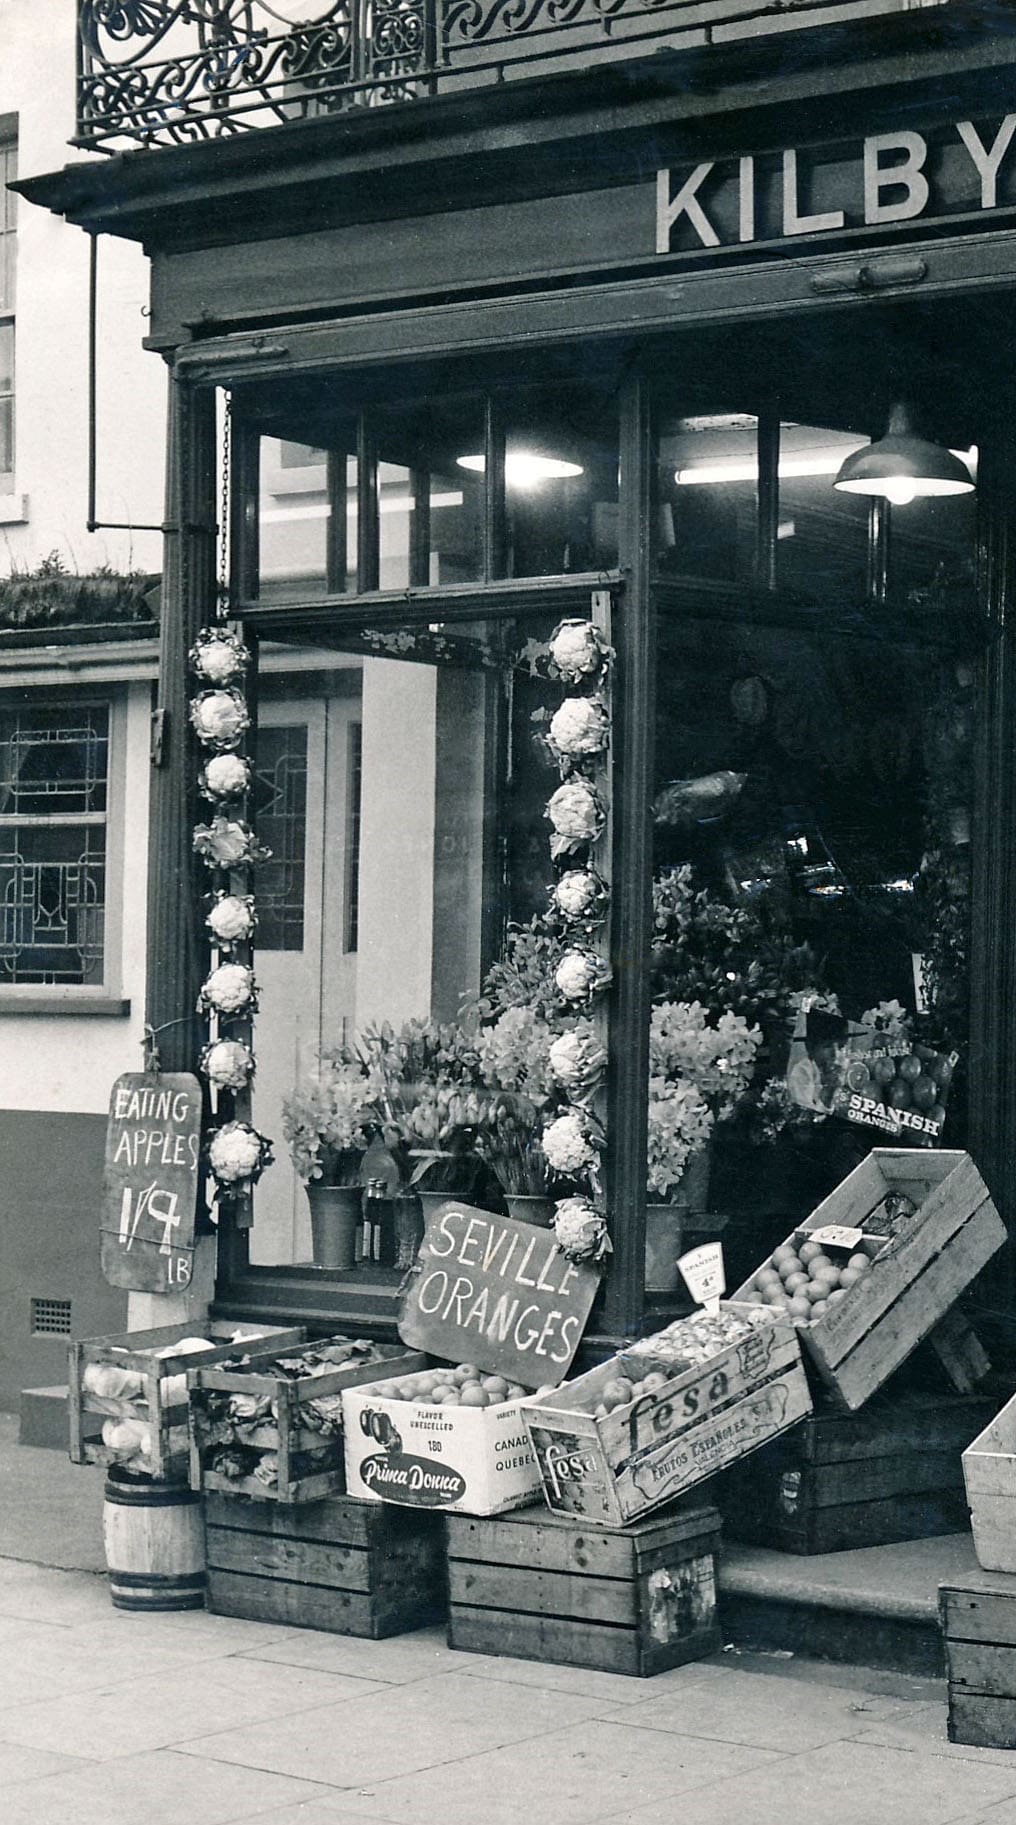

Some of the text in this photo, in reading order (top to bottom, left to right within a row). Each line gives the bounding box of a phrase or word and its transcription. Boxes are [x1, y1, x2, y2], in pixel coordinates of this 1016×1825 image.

[114, 1087, 189, 1122] EATING
[847, 1109, 898, 1132] ORANGES
[849, 1094, 940, 1136] SPANISH
[113, 1129, 200, 1170] APPLES
[118, 1180, 181, 1255] 1/9
[429, 1212, 579, 1296] SEVILLE
[418, 1270, 580, 1363] ORANGES
[410, 1420, 455, 1432] UNEXCELLED
[417, 1411, 444, 1421] FLAVOR
[622, 1370, 728, 1453] fesa
[427, 1440, 443, 1453] 180
[494, 1435, 529, 1452] CANAD
[364, 1460, 461, 1491] Prima Donna
[544, 1445, 598, 1499] fesa
[650, 1452, 688, 1482] FRUTOS
